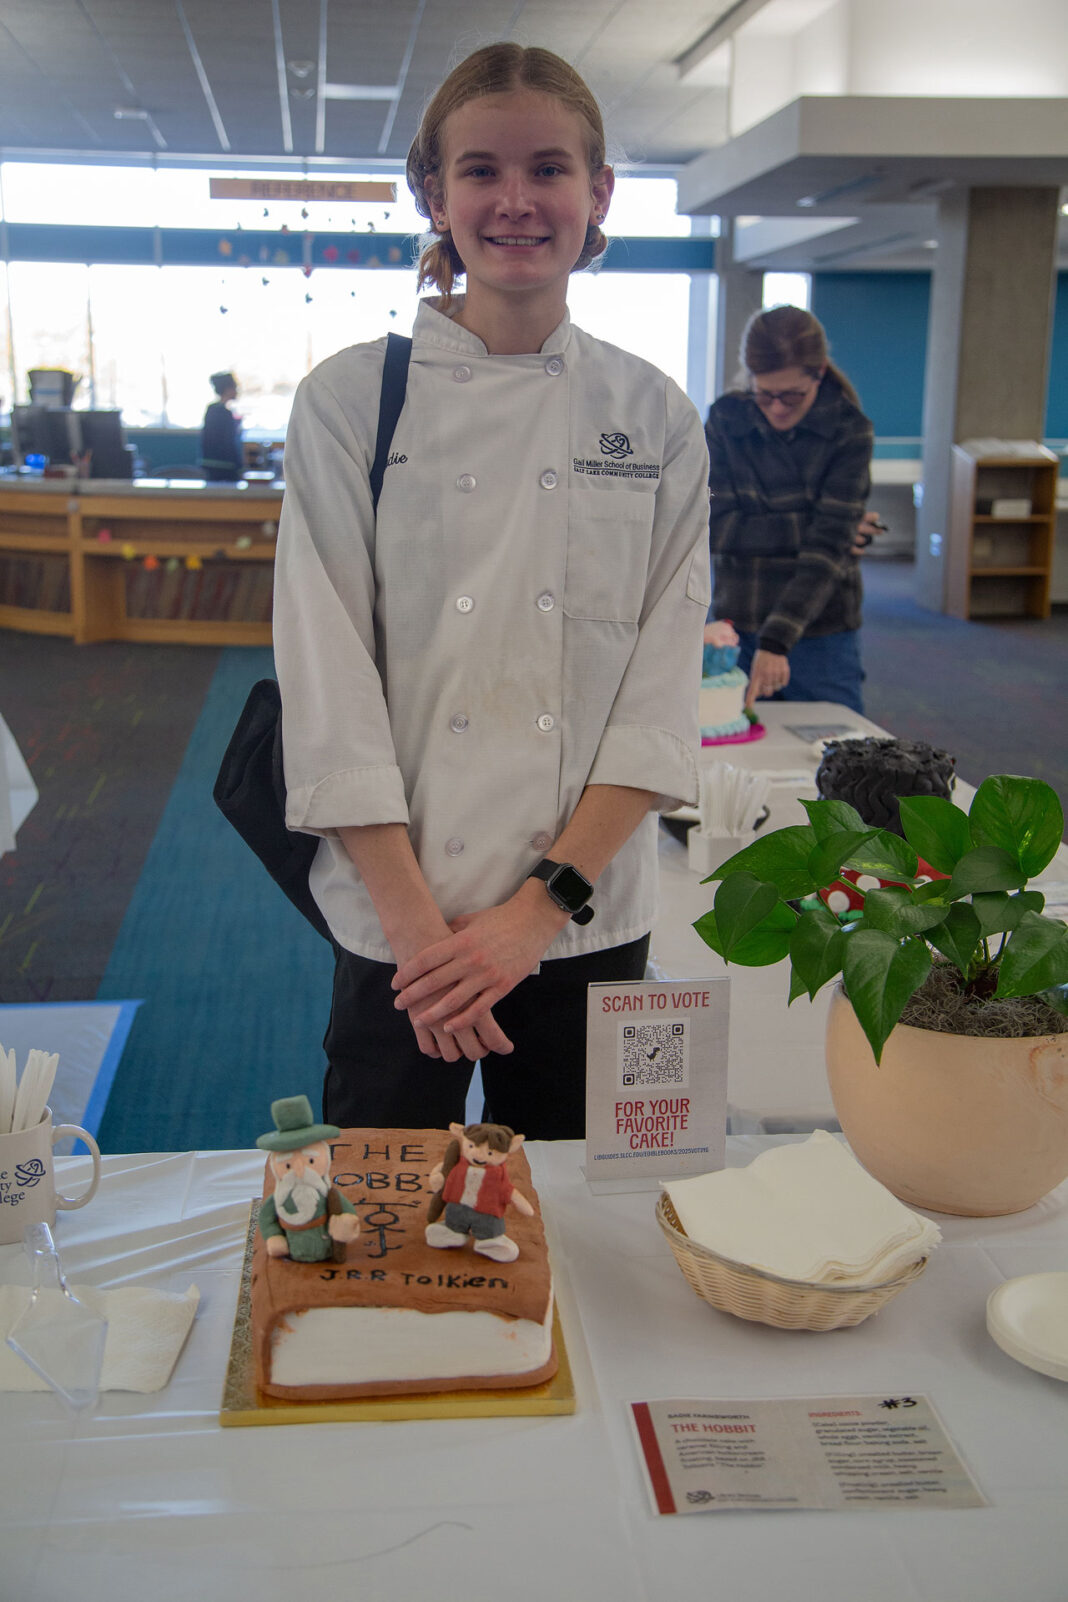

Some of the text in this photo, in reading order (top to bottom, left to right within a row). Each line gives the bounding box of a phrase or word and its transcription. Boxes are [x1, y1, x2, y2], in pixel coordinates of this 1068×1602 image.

[387, 452, 408, 466] die
[573, 458, 585, 466] Gail
[604, 461, 625, 469] School
[632, 463, 660, 471] Business
[602, 991, 710, 1013] SCAN TO VOTE
[615, 1098, 690, 1118] FOR YOUR
[616, 1114, 688, 1135] FAVORITE
[629, 1131, 674, 1150] CAKE!
[329, 1143, 428, 1162] THE
[332, 1171, 435, 1194] OBB
[0, 1191, 25, 1206] lege
[877, 1397, 917, 1410] #3
[671, 1423, 756, 1434] THE HOBBIT
